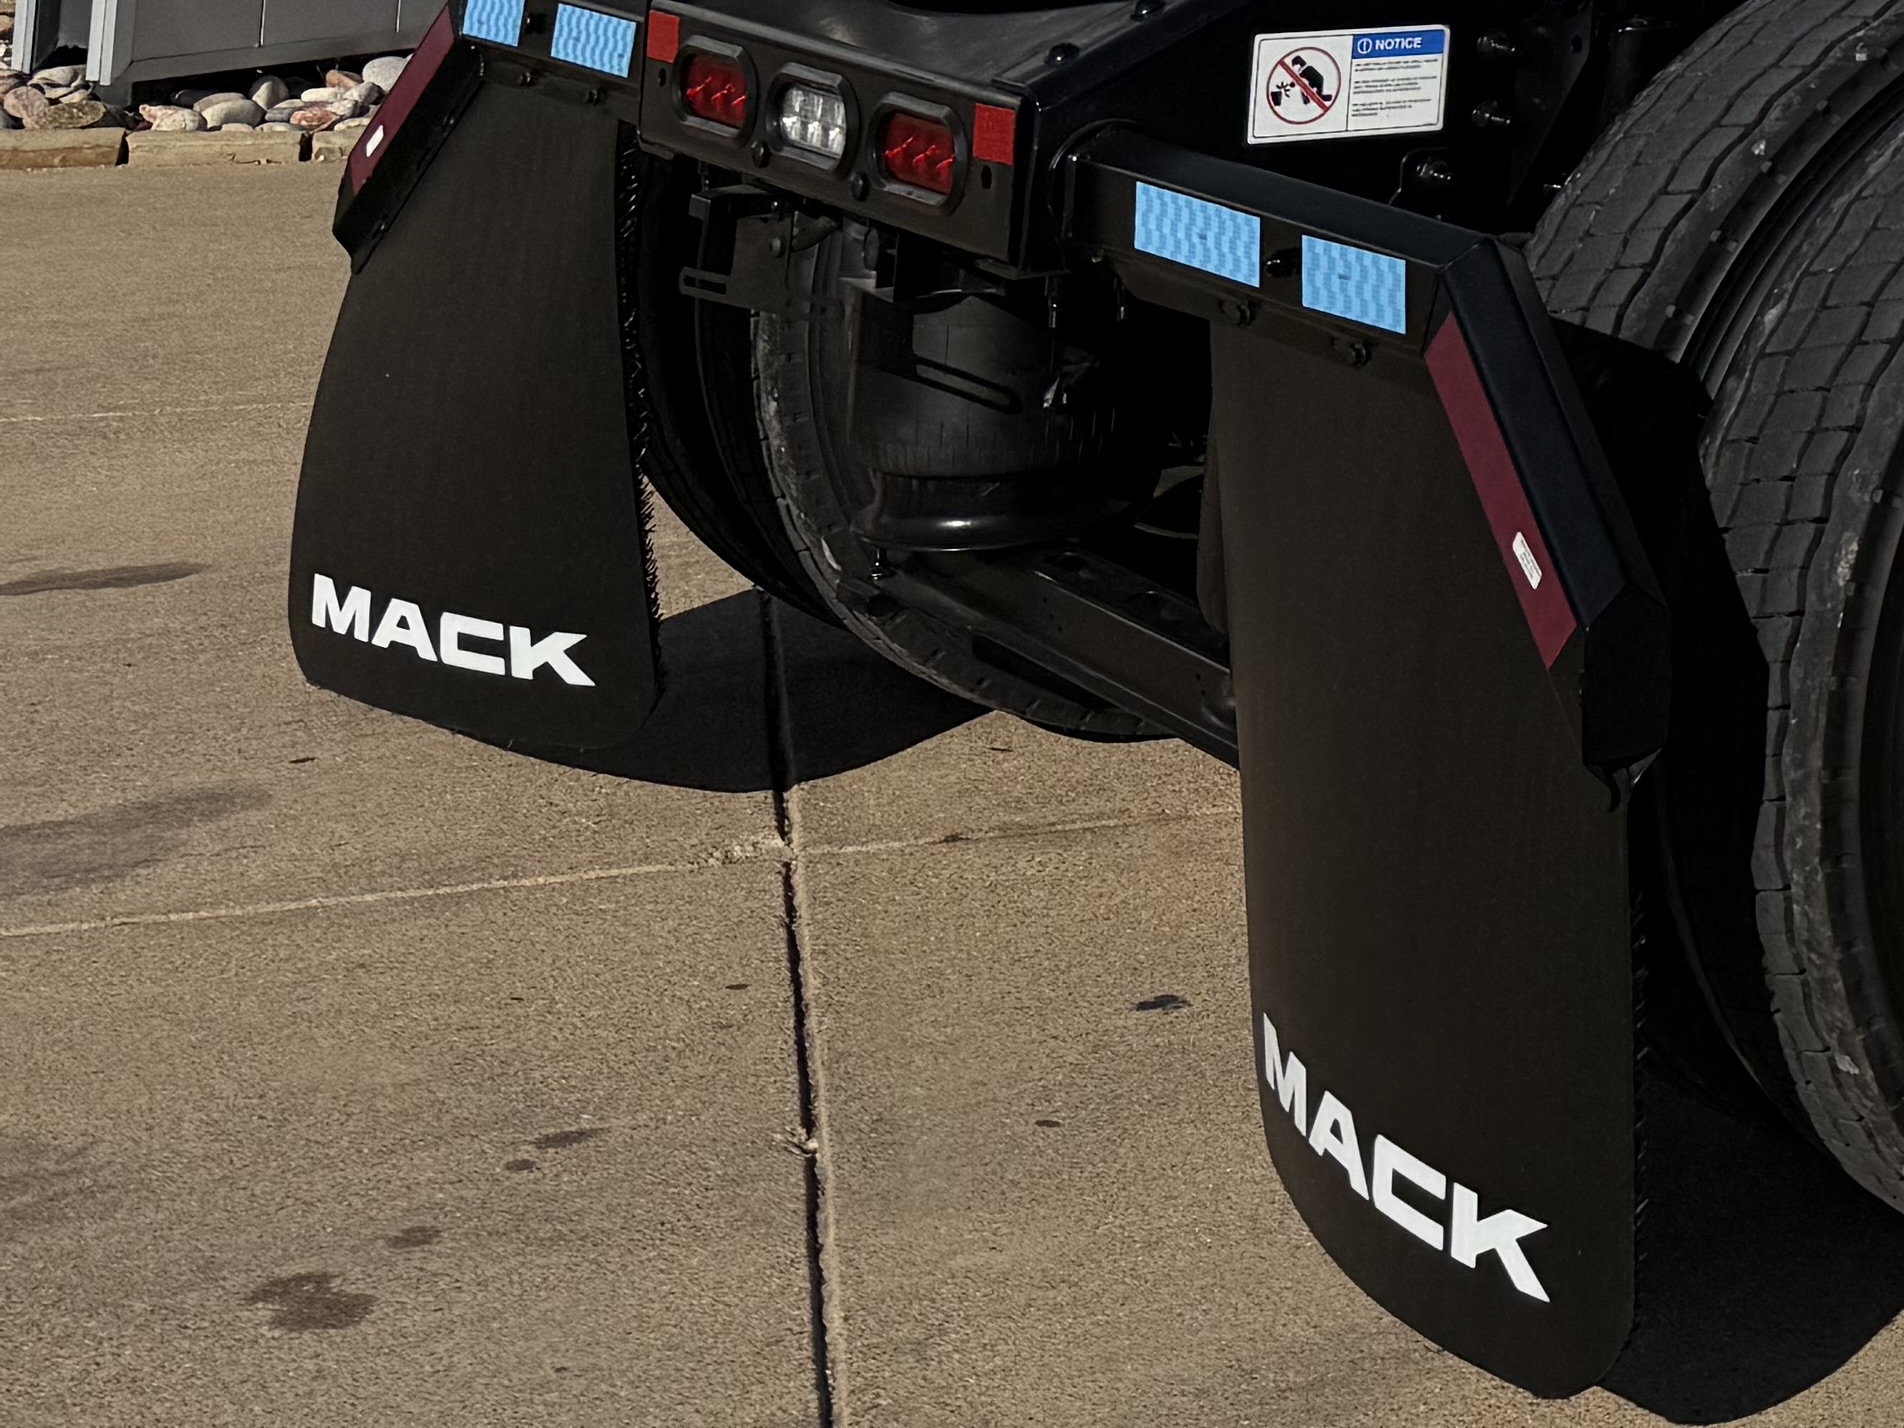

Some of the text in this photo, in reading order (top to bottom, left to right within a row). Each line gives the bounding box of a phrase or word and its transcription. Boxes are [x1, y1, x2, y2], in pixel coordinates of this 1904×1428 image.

[1375, 37, 1422, 51] NOTICE
[311, 572, 597, 687] MACK
[1263, 1011, 1551, 1304] MACK
